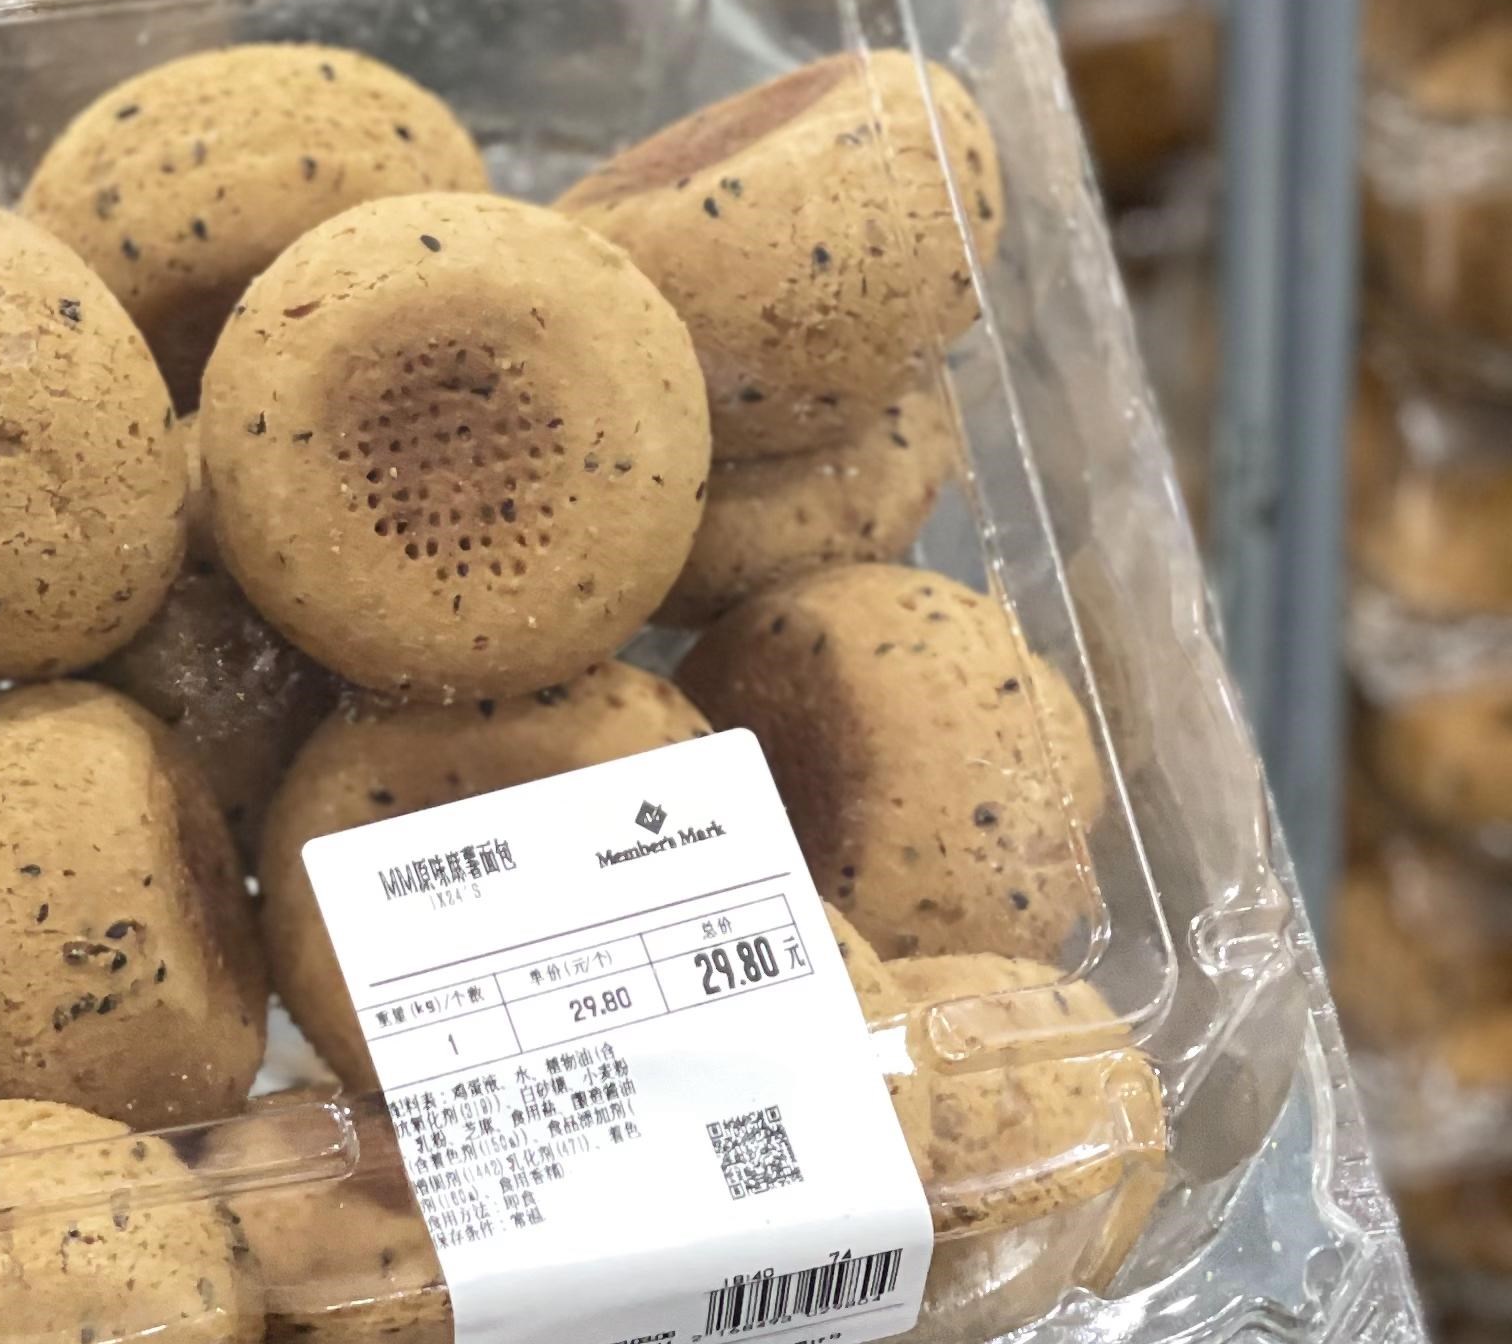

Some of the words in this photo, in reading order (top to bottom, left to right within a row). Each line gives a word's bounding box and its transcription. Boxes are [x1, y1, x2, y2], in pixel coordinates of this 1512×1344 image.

[595, 835, 678, 869] Member's
[677, 820, 728, 847] Mark
[701, 916, 733, 940] 总价
[694, 935, 780, 997] 29.80
[782, 935, 806, 971] 元
[568, 986, 633, 1023] 29.80
[447, 1033, 459, 1056] 1
